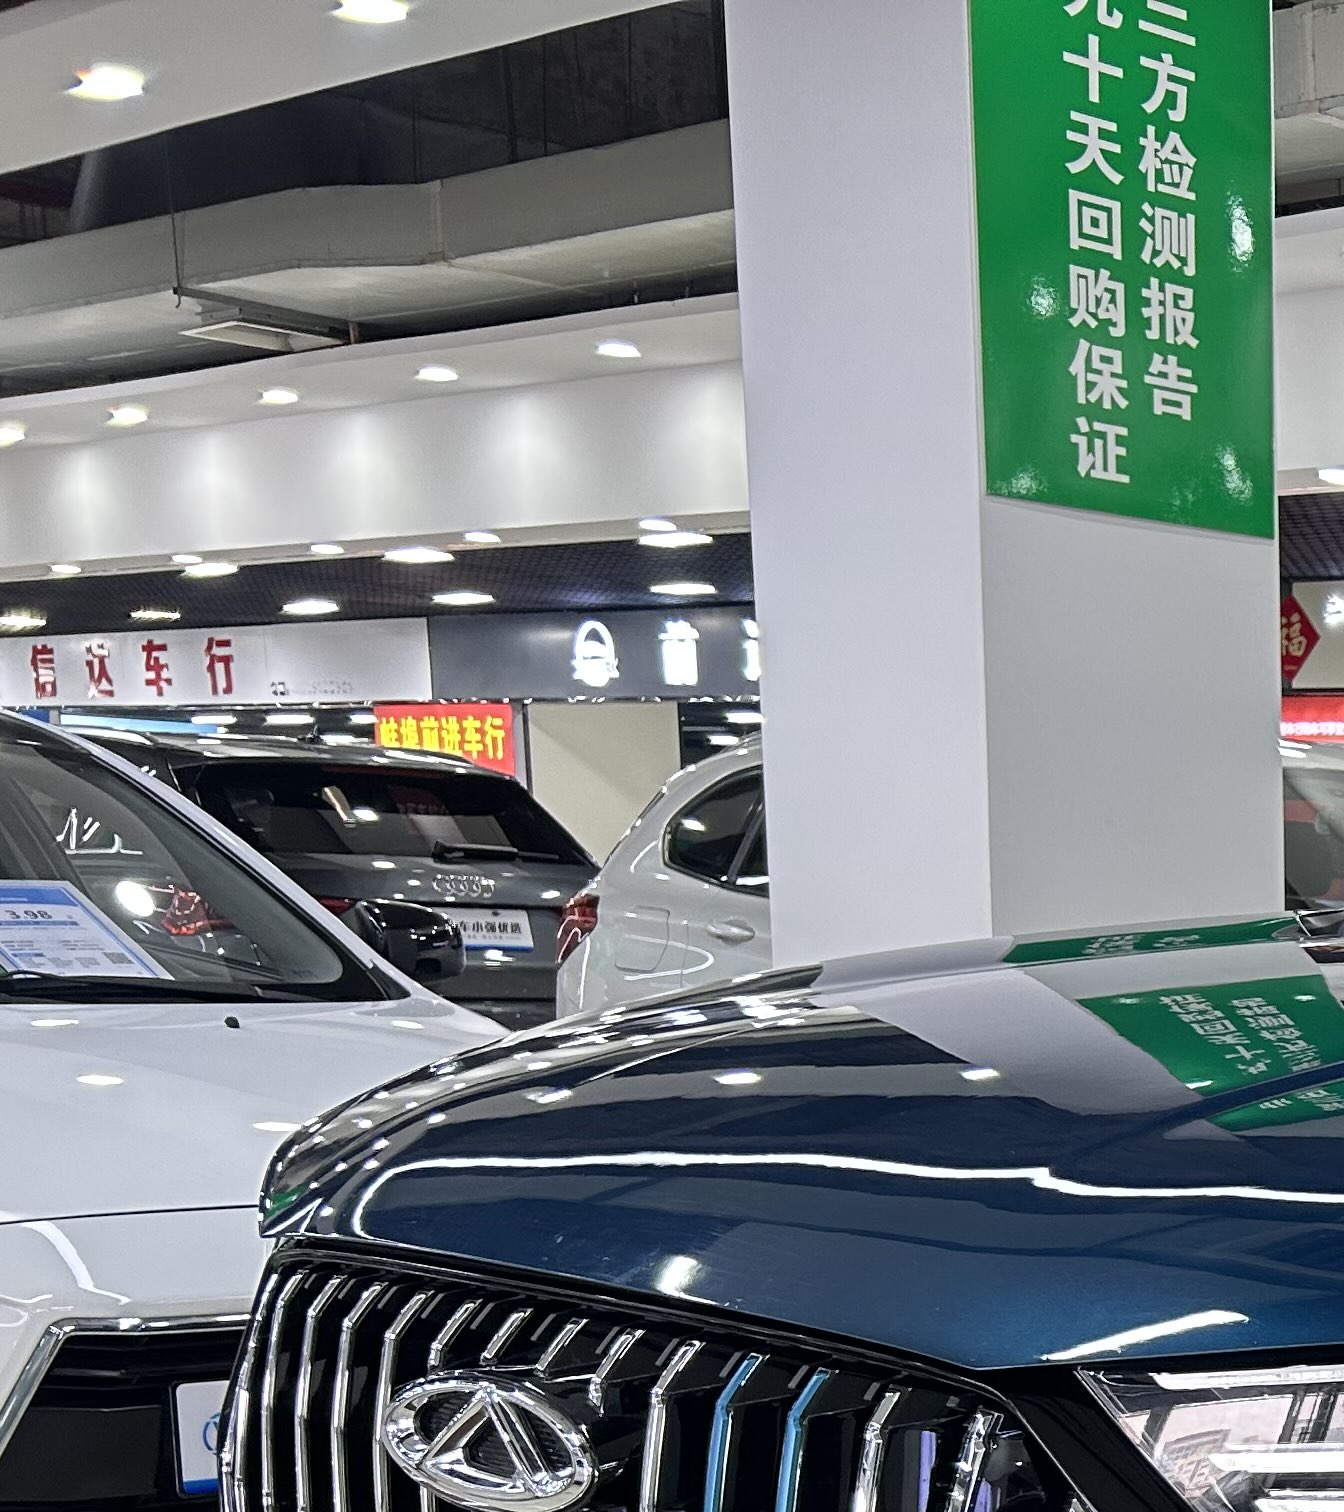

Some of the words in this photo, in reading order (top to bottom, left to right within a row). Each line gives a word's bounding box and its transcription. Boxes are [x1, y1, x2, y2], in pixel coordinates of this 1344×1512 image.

[30, 635, 235, 699] 信达车行
[380, 714, 505, 761] 蚌埠前进车行
